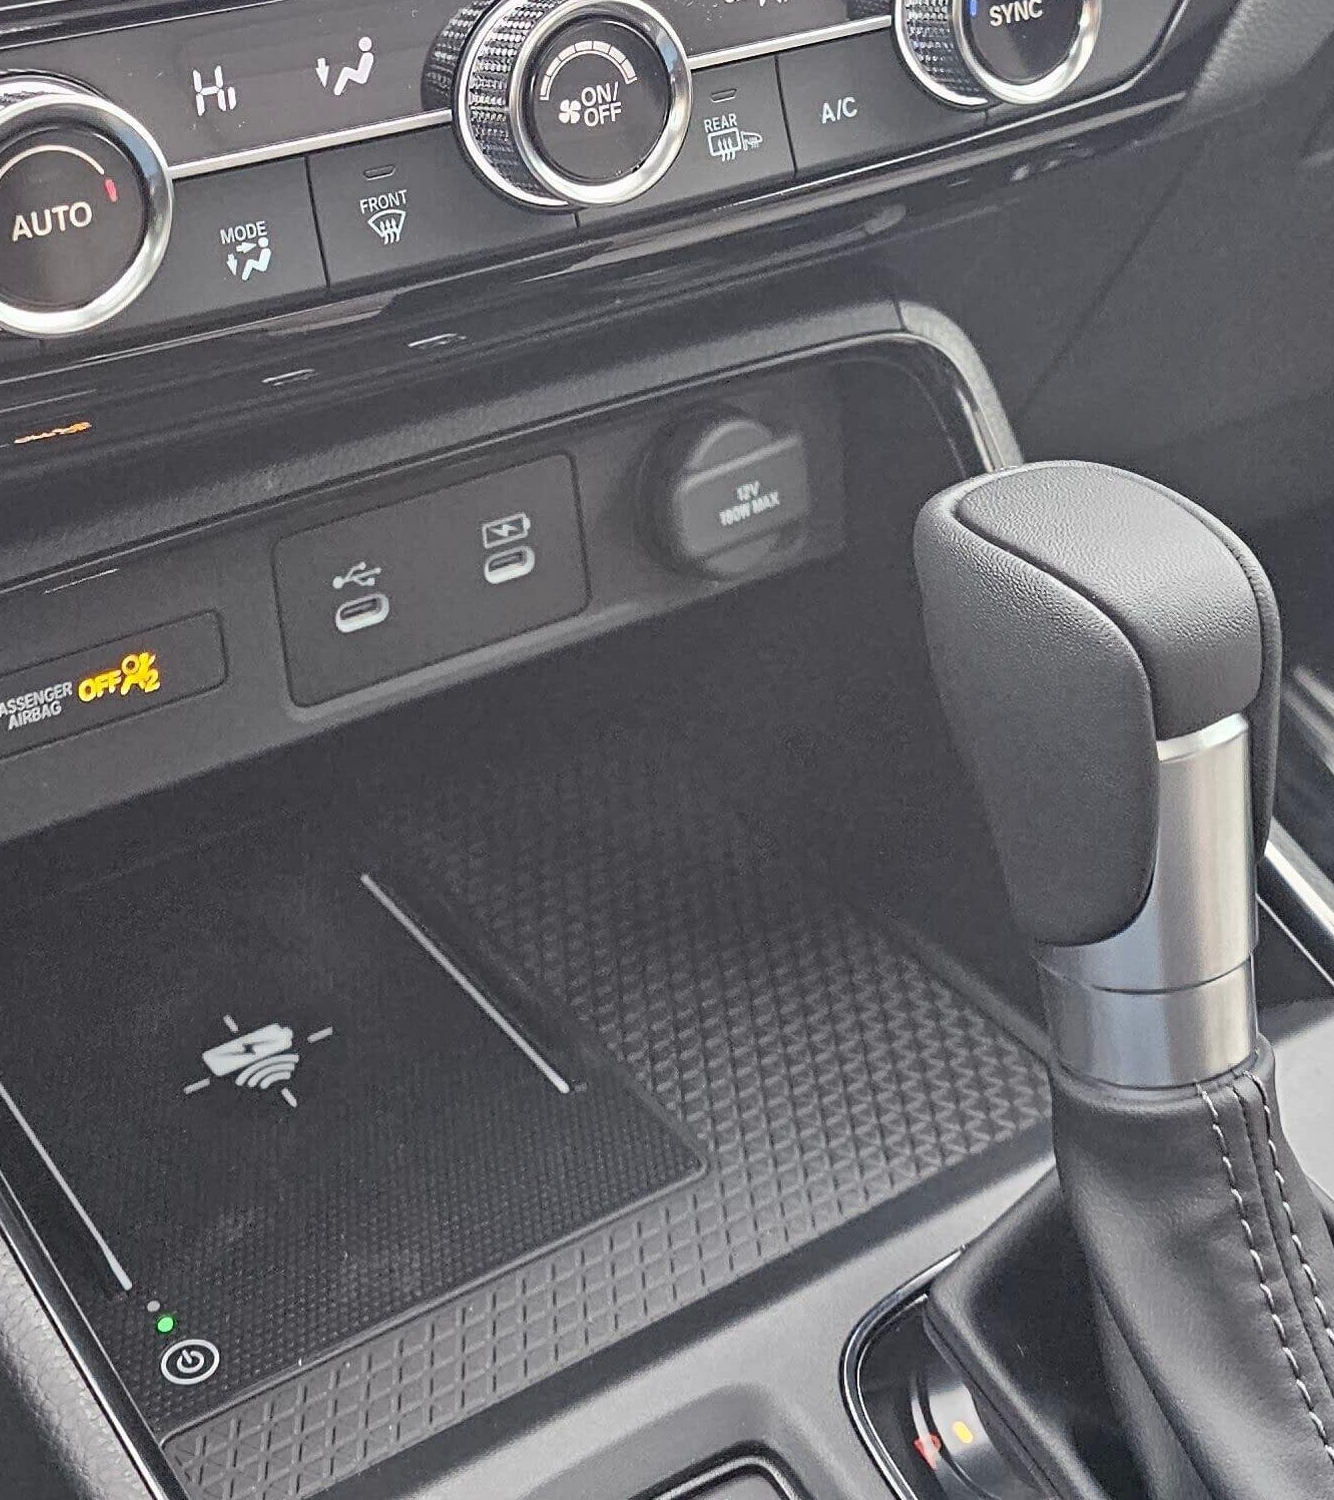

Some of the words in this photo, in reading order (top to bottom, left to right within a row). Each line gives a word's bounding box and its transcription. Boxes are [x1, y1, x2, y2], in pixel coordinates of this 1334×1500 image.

[581, 82, 618, 114] ON/
[820, 96, 858, 125] A/C
[584, 100, 623, 127] OFF
[704, 112, 738, 133] REAR
[359, 189, 408, 215] FRONT
[11, 200, 93, 242] AUTO
[219, 220, 267, 244] MODE
[77, 669, 122, 702] OFF
[8, 700, 62, 730] AIRBAG
